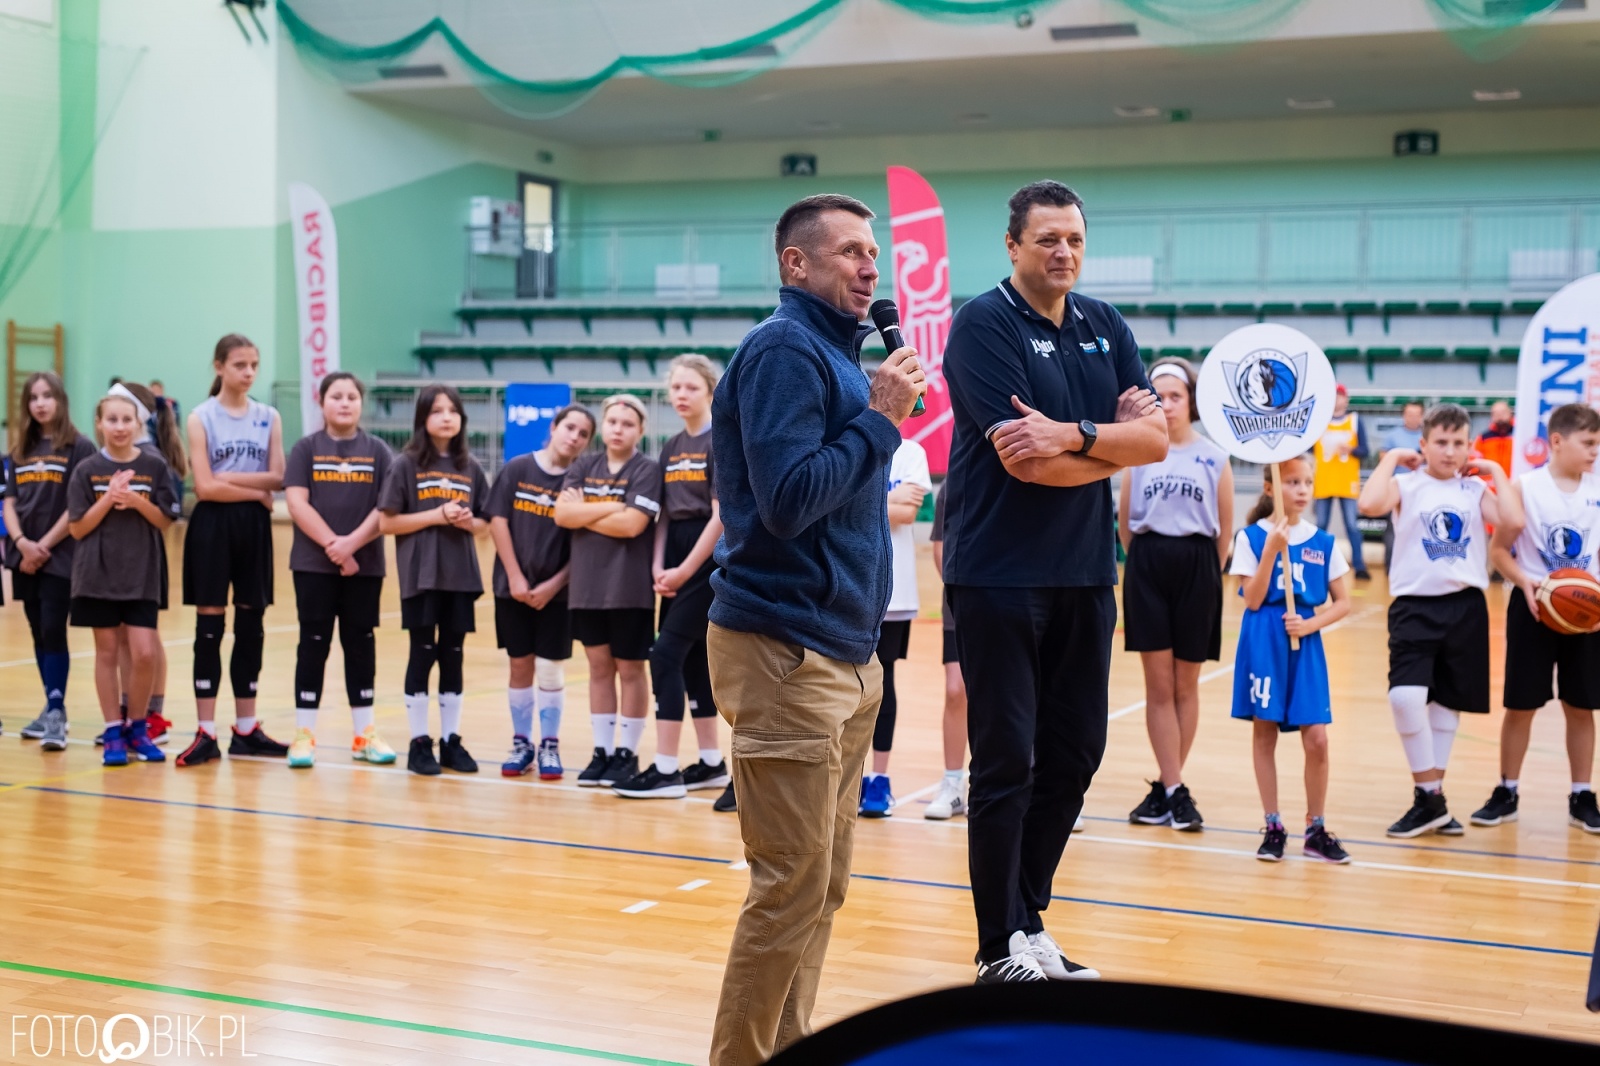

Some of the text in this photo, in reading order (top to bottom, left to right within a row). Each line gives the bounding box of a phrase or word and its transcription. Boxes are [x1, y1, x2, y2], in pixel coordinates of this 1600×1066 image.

[312, 470, 374, 483] BASKETBALL
[1143, 481, 1204, 503] SPURS
[513, 498, 556, 518] BASKETB
[1276, 560, 1306, 592] 24
